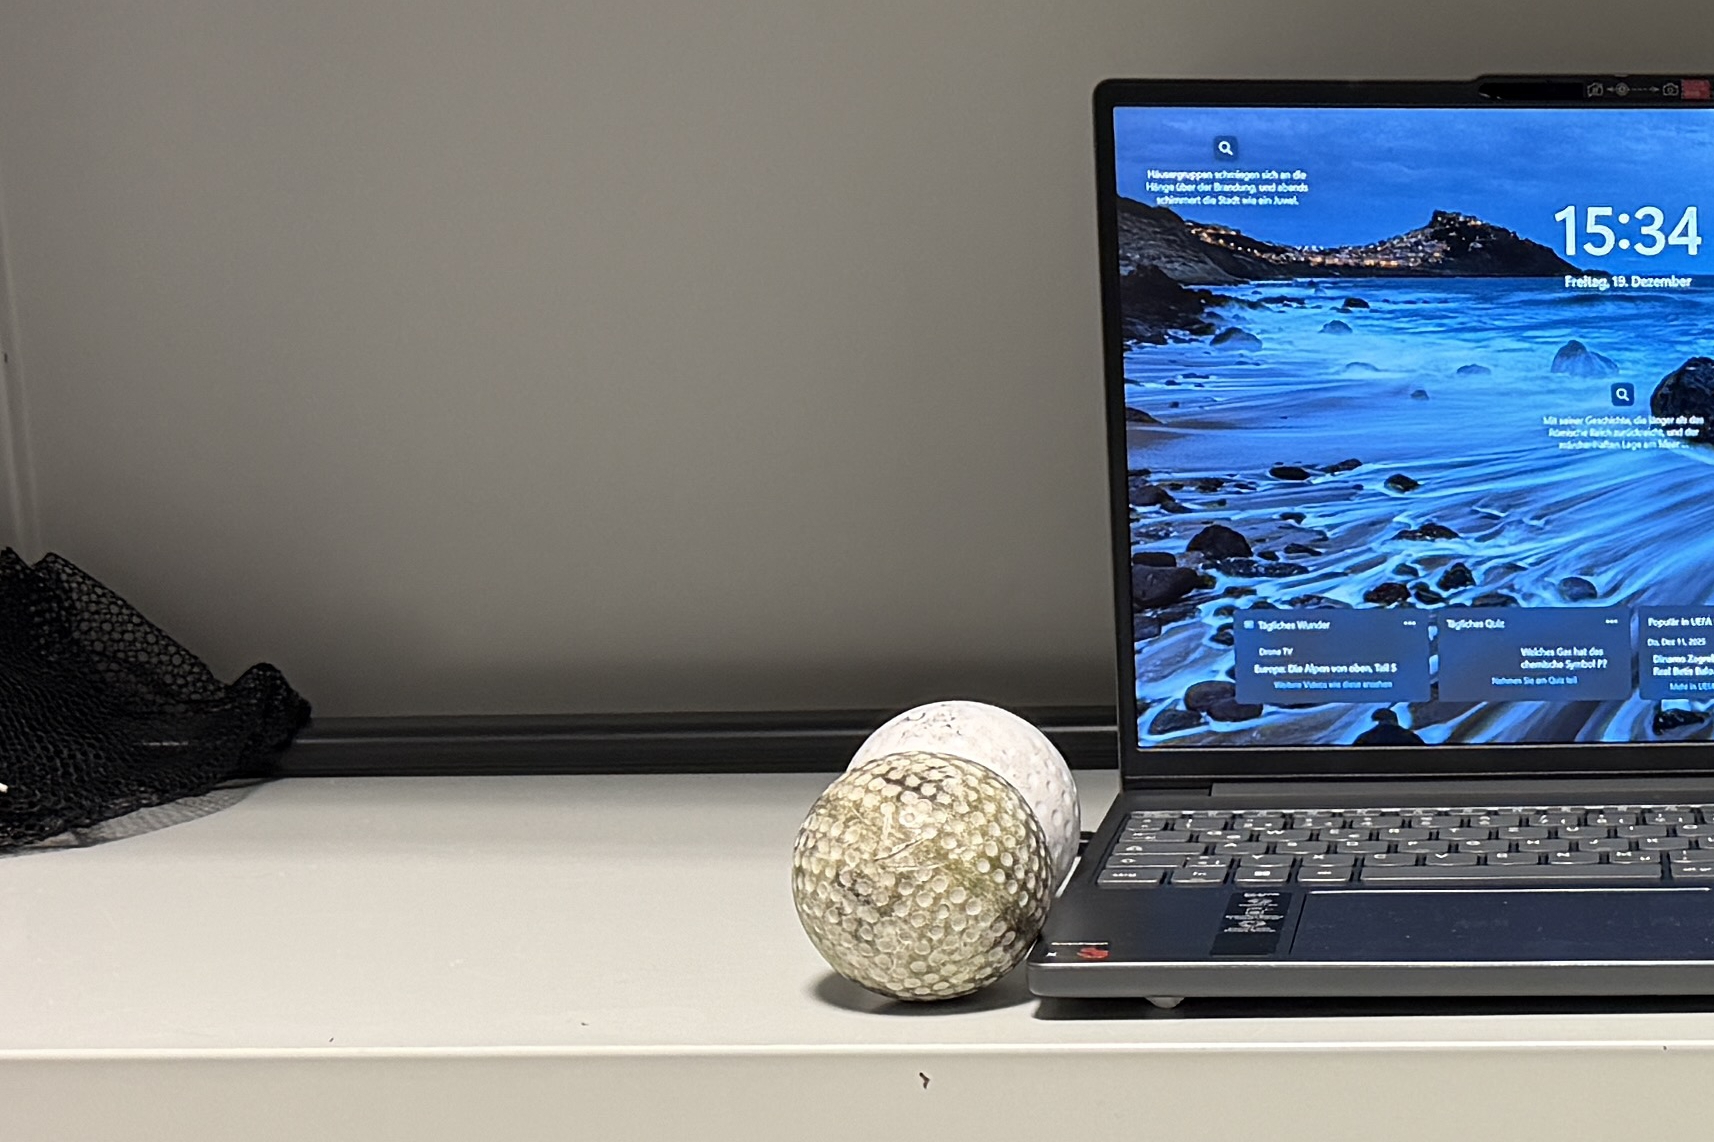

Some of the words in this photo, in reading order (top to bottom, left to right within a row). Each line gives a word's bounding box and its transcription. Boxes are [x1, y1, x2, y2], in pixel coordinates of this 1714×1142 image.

[1262, 170, 1278, 179] sich
[1292, 170, 1307, 179] die
[1146, 182, 1175, 193] Hänge
[1176, 182, 1196, 191] über
[1197, 182, 1212, 191] der
[1213, 182, 1257, 194] Brandung,
[1258, 182, 1276, 191] und
[1277, 182, 1308, 191] abends
[1156, 195, 1201, 205] schimmert
[1202, 195, 1217, 205] die
[1218, 195, 1240, 205] Stadt
[1242, 195, 1257, 205] wie
[1258, 195, 1272, 205] ein
[1273, 195, 1299, 205] Juwel.
[1554, 205, 1702, 256] 15:34
[1564, 275, 1610, 290] Freitag,
[1612, 275, 1629, 288] 19.
[1631, 275, 1692, 288] Dezember
[1585, 416, 1632, 425] Geschichte,
[1633, 416, 1647, 425] die
[1676, 416, 1687, 425] als
[1689, 416, 1704, 425] das
[1666, 428, 1683, 437] und
[1685, 428, 1699, 437] der
[1622, 440, 1642, 451] Lage
[1258, 620, 1295, 632] Tägliches
[1297, 620, 1330, 630] Wunder
[1446, 619, 1483, 630] Tägliches
[1485, 619, 1505, 629] Quiz
[1648, 617, 1679, 628] Populär
[1681, 617, 1689, 627] in
[1691, 617, 1712, 627] UEFA
[1647, 638, 1660, 646] Do,
[1282, 647, 1293, 656] TV
[1520, 647, 1554, 657] Welches
[1556, 647, 1572, 657] Gas
[1573, 647, 1587, 657] hat
[1589, 647, 1604, 657] das
[1653, 654, 1686, 663] Dinamo
[1288, 663, 1303, 673] Die
[1304, 663, 1330, 675] Alpen
[1349, 663, 1373, 674] oben,
[1374, 663, 1389, 673] Teil
[1520, 659, 1564, 668] chemische
[1565, 659, 1596, 670] Symbol
[1653, 667, 1671, 676] Real
[1673, 667, 1693, 676] Betis
[1548, 676, 1565, 685] Quiz
